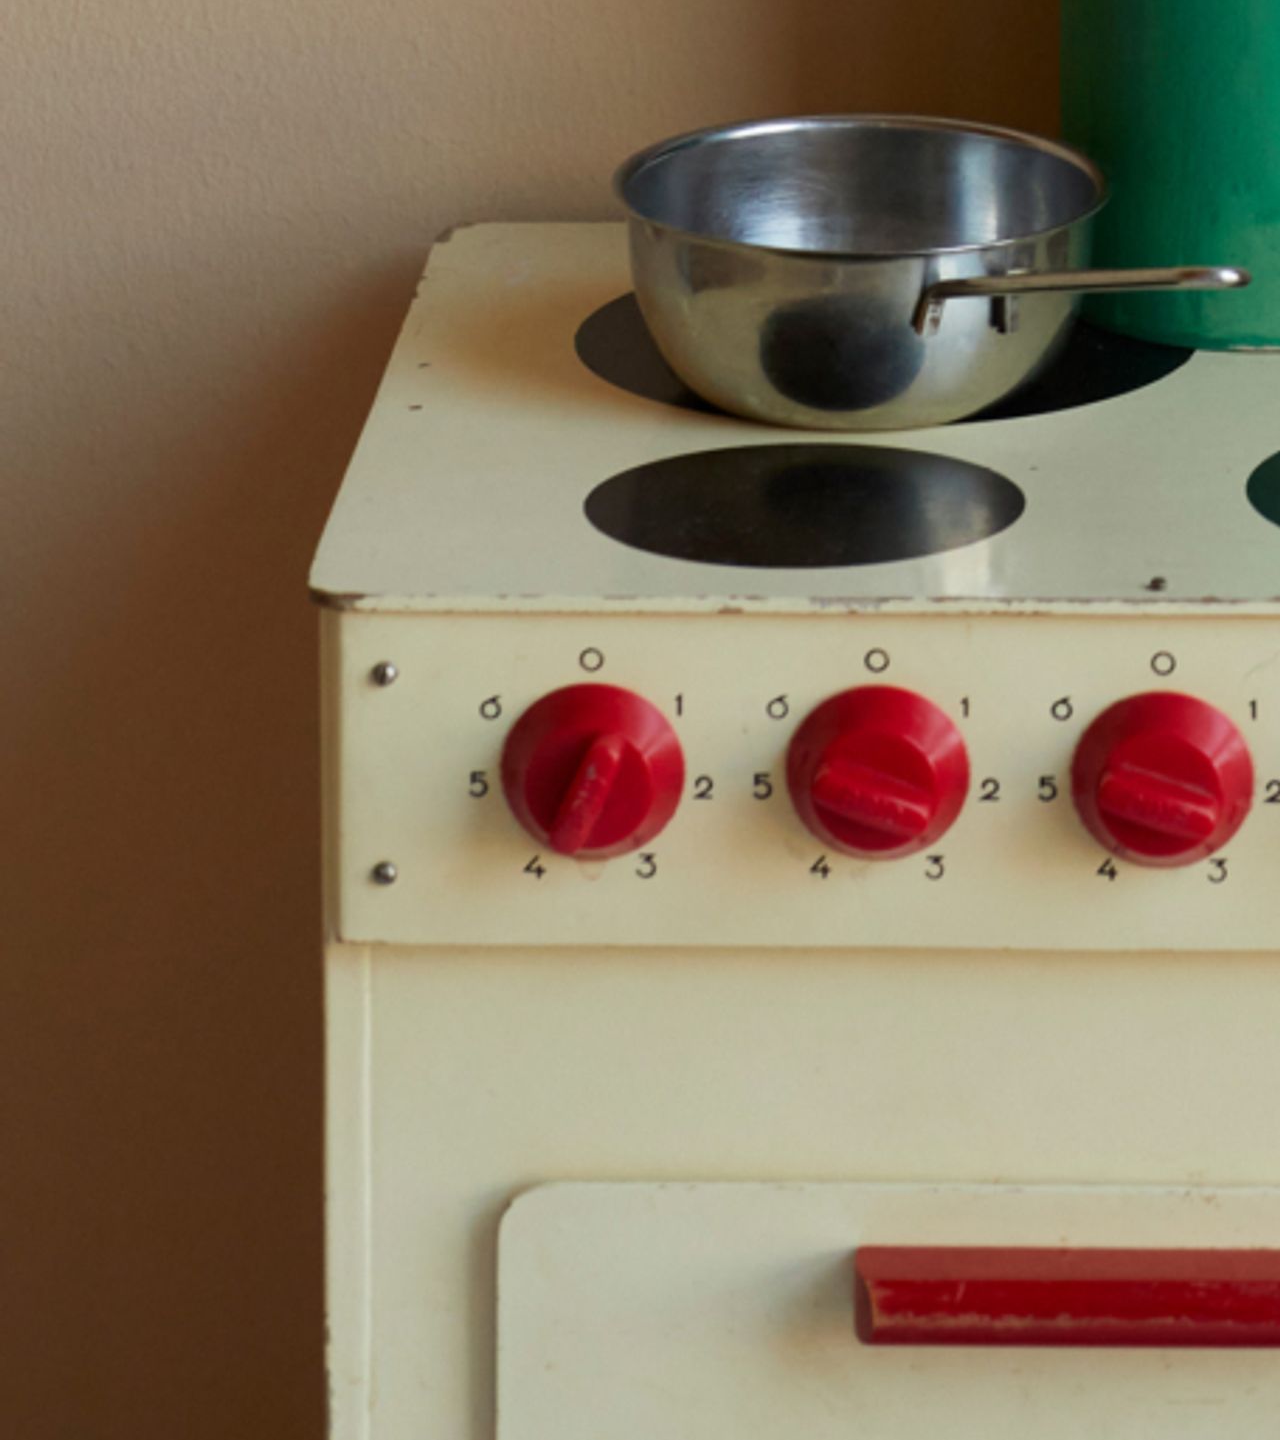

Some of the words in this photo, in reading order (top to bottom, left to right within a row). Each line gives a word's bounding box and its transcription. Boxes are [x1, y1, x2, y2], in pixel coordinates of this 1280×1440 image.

[469, 770, 489, 798] 5
[693, 774, 714, 800] 2
[753, 773, 773, 801] 5
[979, 776, 1001, 802] 2
[1038, 775, 1058, 803] 5
[523, 854, 546, 880] 4
[635, 852, 658, 880] 3
[809, 854, 831, 879] 4
[924, 854, 945, 881] 3
[1096, 858, 1118, 882] 4
[1207, 857, 1228, 884] 3
